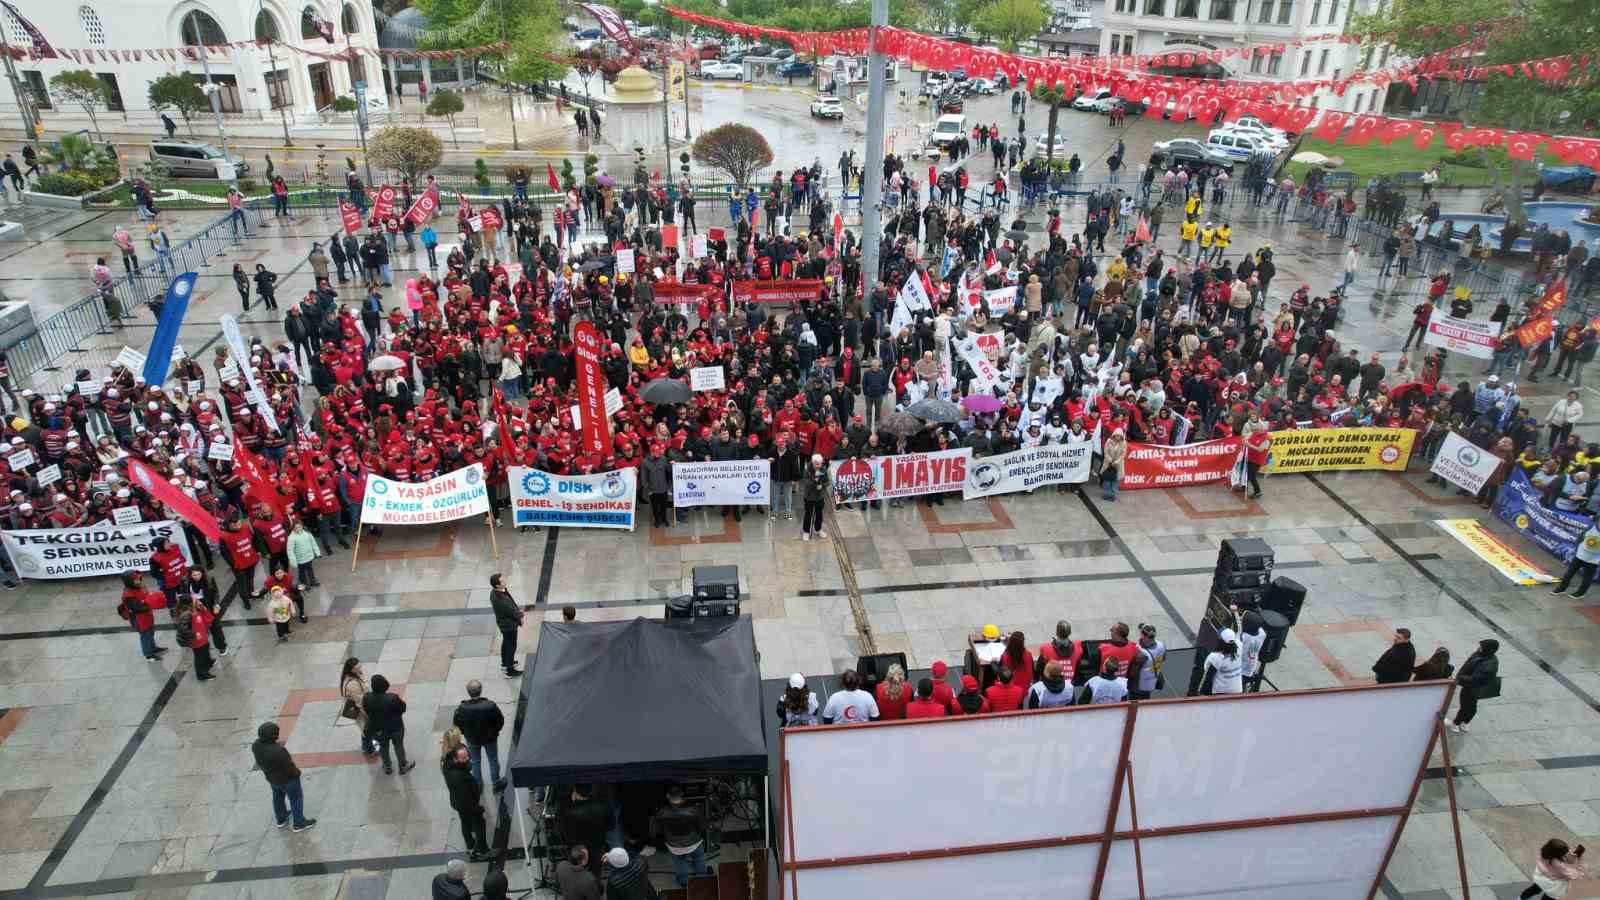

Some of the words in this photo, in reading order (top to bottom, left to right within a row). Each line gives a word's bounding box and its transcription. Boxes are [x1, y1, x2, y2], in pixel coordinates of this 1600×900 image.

[1004, 454, 1026, 466] SAĞLIK
[1027, 452, 1036, 462] VE
[1036, 450, 1060, 460] SOSYAL
[1062, 447, 1085, 458] HİZMET
[1280, 457, 1314, 467] EMEKLİ
[852, 460, 857, 473] 1
[881, 457, 893, 491] 1
[896, 456, 967, 489] MAYIS
[838, 472, 870, 484] MAYIS
[1023, 472, 1064, 486] BANDIRMA
[397, 478, 457, 500] YAŞASIN
[558, 480, 593, 494] DİSK
[365, 494, 376, 510] İŞ
[386, 501, 423, 512] EKMEK
[516, 498, 553, 508] GENEL
[382, 504, 467, 523] MÜCADELEMİZ
[13, 529, 127, 546] TEKGIDA
[149, 525, 174, 538] İŞ
[46, 559, 114, 575] BANDIRMA
